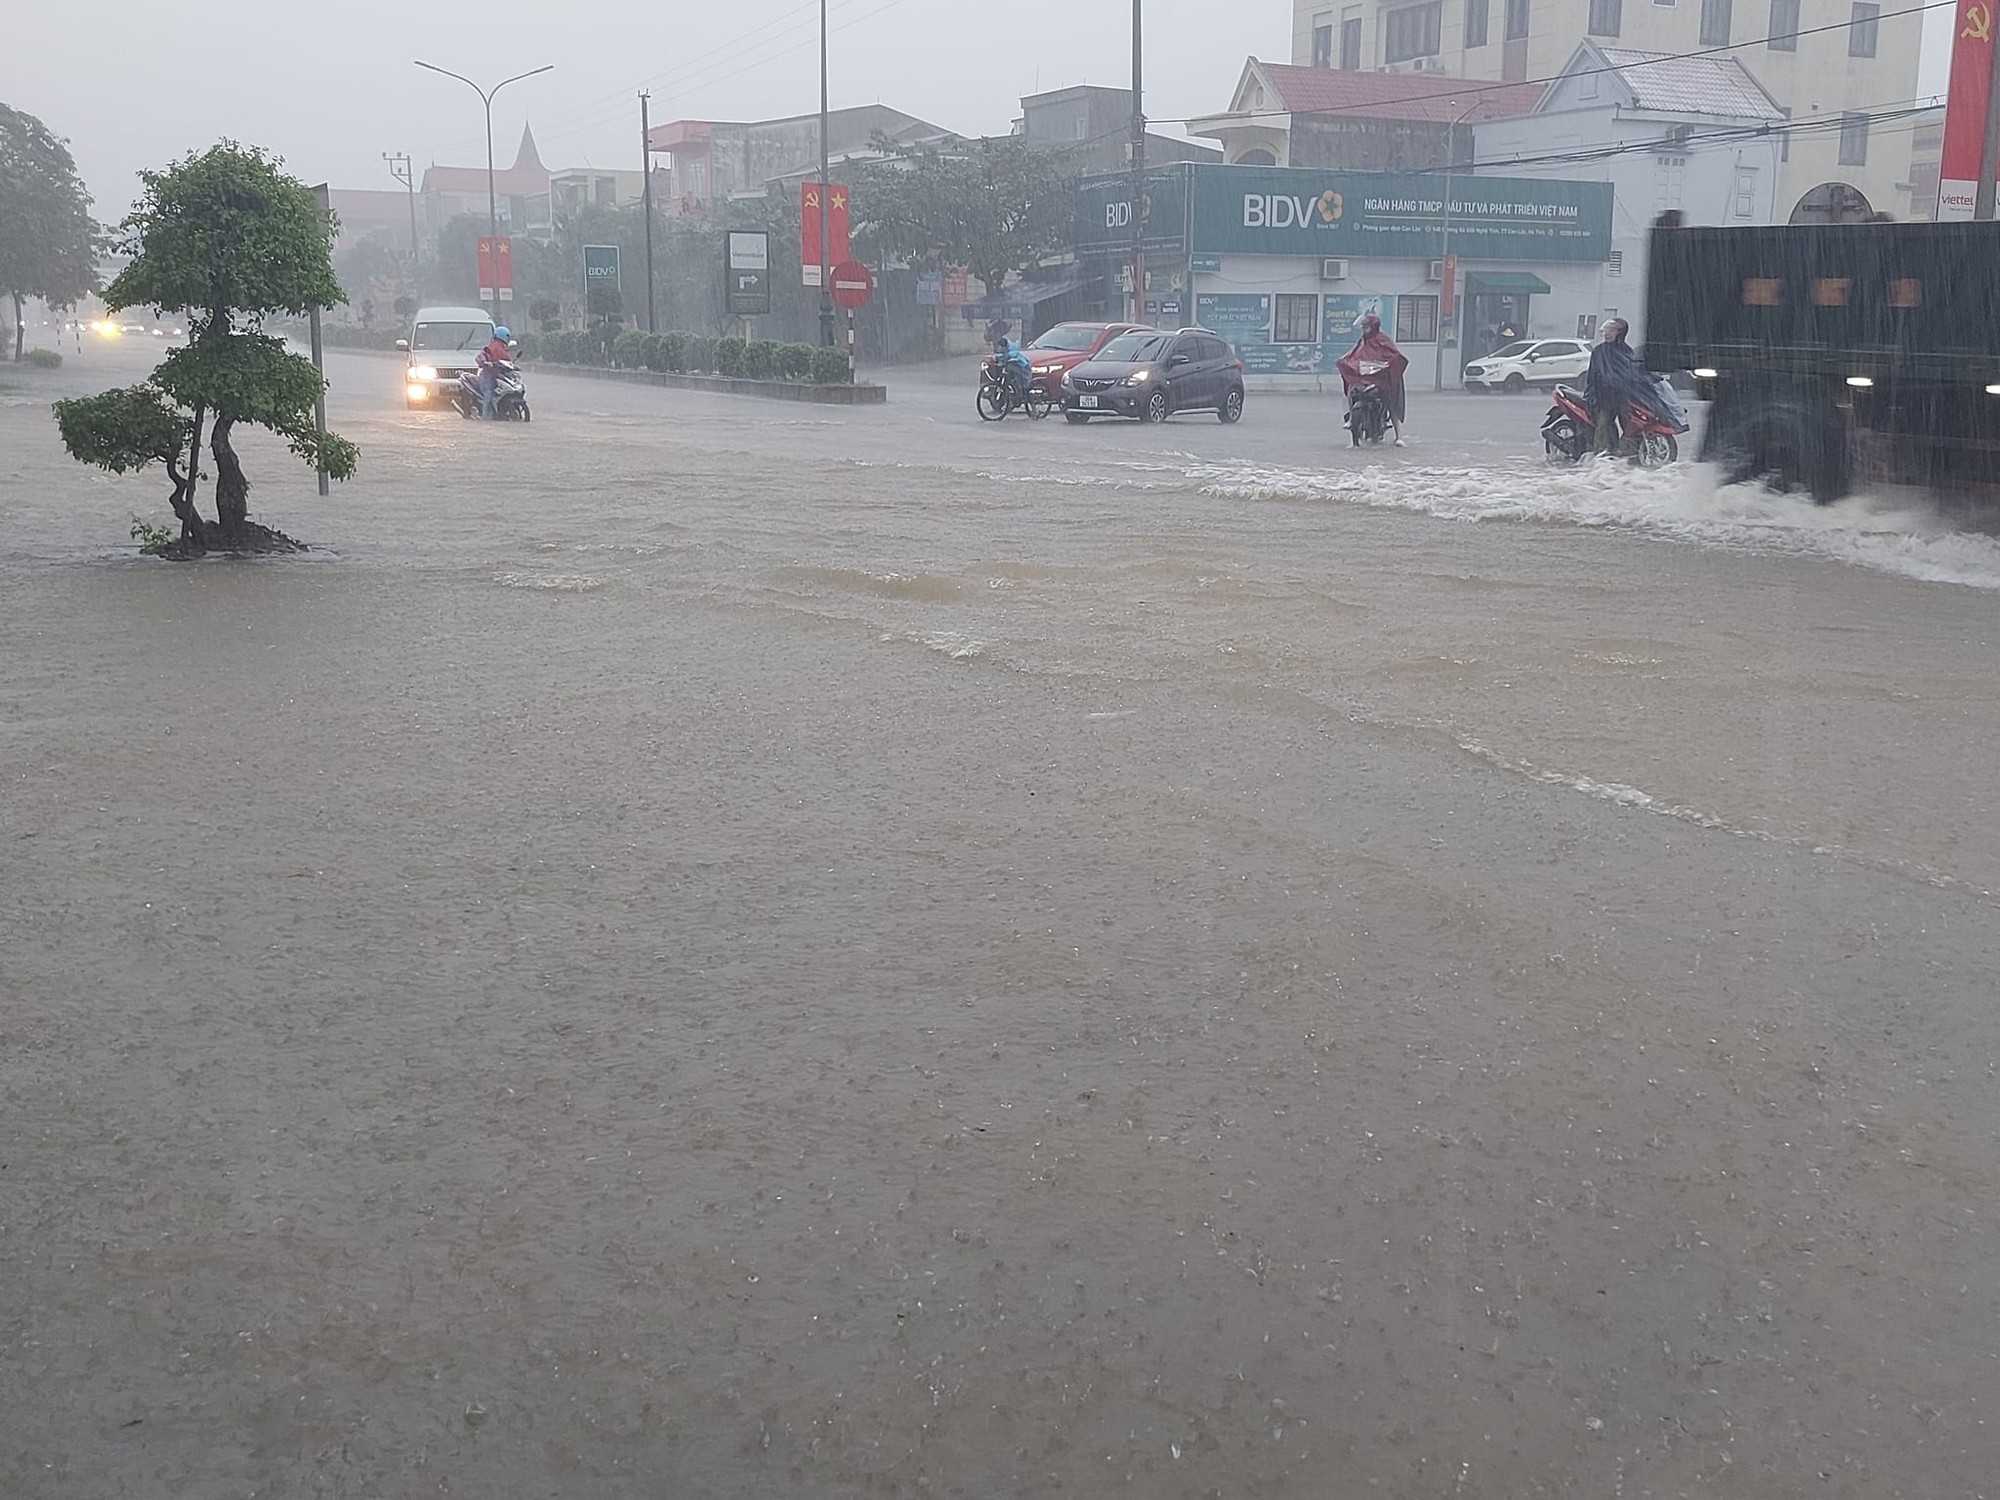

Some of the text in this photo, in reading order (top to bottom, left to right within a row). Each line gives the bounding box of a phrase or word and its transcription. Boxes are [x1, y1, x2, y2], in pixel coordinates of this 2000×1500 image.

[1364, 197, 1390, 211] NGÂN
[1391, 198, 1416, 212] HÀNG
[1418, 200, 1443, 212] TMCP
[1463, 201, 1478, 214] TƯ
[1489, 201, 1512, 215] PHÁT
[1539, 203, 1558, 218] VIỆT
[1558, 205, 1578, 217] NAM
[1942, 194, 1974, 206] viettel
[1243, 194, 1318, 229] BIDV
[588, 266, 608, 276] BIDV
